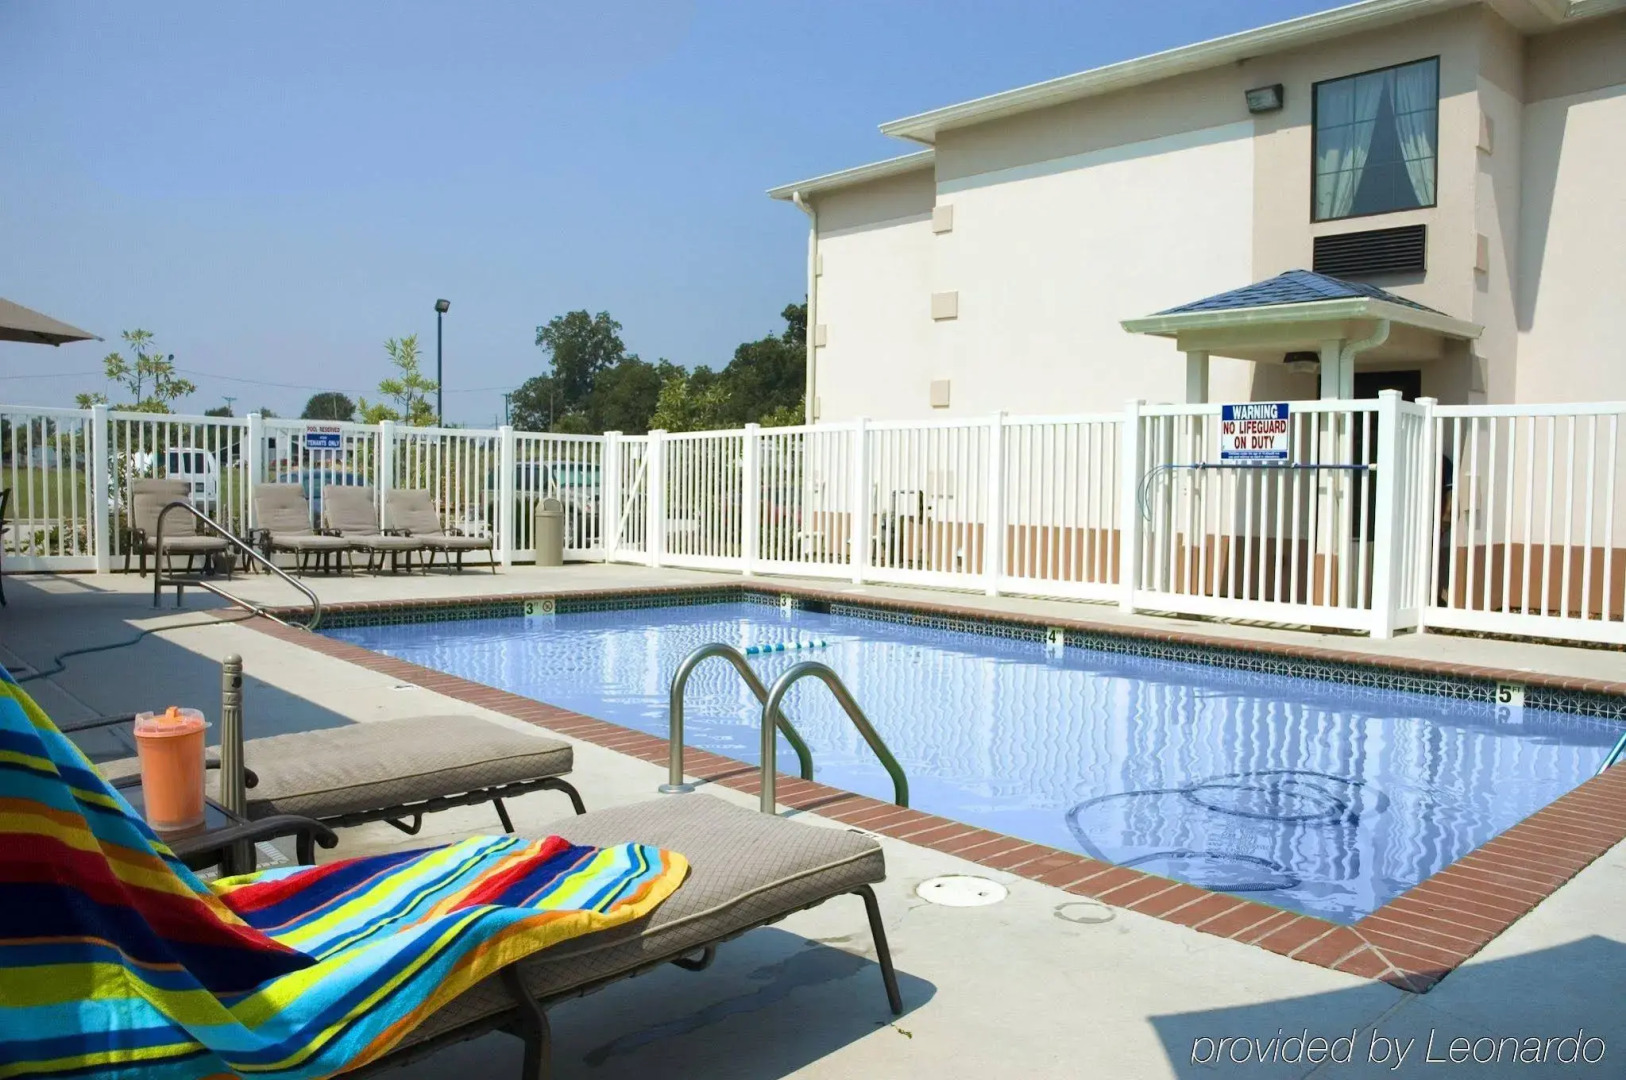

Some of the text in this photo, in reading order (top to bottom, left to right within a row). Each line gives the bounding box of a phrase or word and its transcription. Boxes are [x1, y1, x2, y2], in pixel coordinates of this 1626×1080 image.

[1232, 404, 1278, 420] WARNING
[1223, 420, 1287, 435] NO LIFEGUARD
[1234, 435, 1275, 450] ON DUTY
[526, 602, 534, 615] 3
[781, 595, 787, 607] 3
[1048, 629, 1057, 644] 4
[1499, 684, 1512, 703] 5
